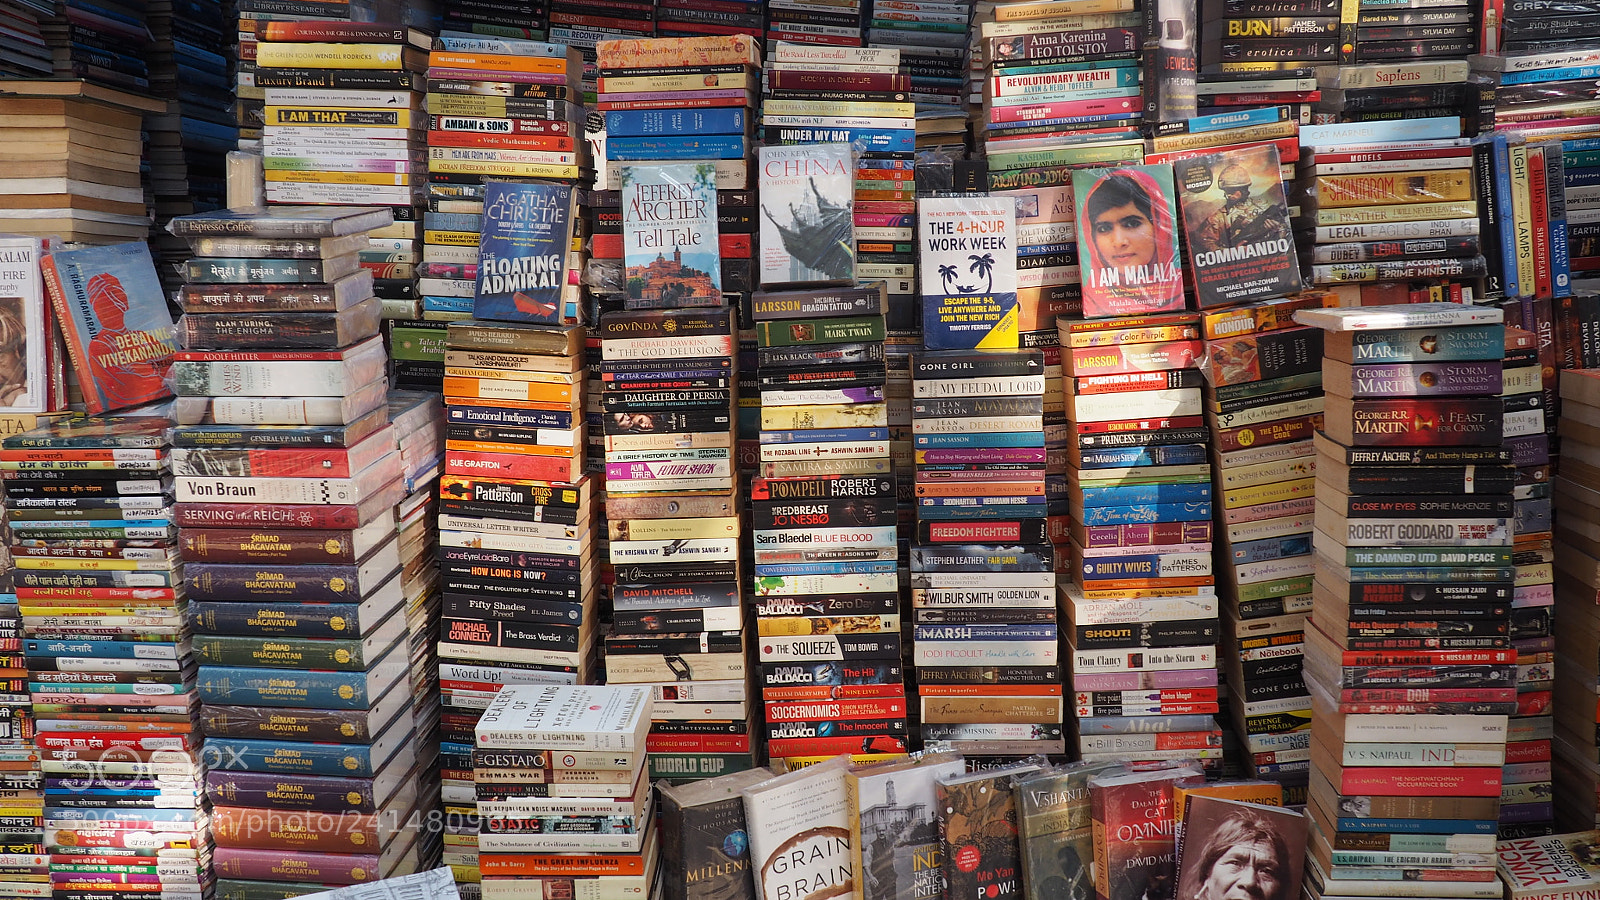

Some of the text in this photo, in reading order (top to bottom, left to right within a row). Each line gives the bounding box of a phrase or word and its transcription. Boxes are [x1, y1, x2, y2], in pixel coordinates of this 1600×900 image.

[1228, 20, 1272, 36] BURN
[1031, 32, 1106, 46] Anna Karenina
[1030, 43, 1108, 59] LEO TOLSTOY
[1165, 56, 1195, 71] JEWELS
[257, 77, 325, 87] Luxury Brand
[1007, 71, 1110, 87] REVOLUTIONARY WEALTH
[1376, 70, 1421, 84] Sapiens
[312, 112, 347, 122] THAT
[1210, 114, 1250, 124] OTHELLO
[445, 120, 509, 131] AMBANI SONS
[780, 129, 850, 141] UNDER MY HAT
[1017, 153, 1054, 161] KASHMIR
[1351, 154, 1382, 162] MODELS
[765, 159, 847, 178] CHINA
[1512, 149, 1524, 181] LIGHT
[1329, 175, 1394, 200] SHANTARAM
[495, 193, 558, 207] AGATHA
[635, 182, 697, 208] JEFFREY
[488, 205, 564, 223] CHRISTIE
[625, 198, 707, 222] ARCHER
[189, 221, 254, 232] Espresso Coffee
[929, 220, 1005, 235] THE 4-HOUR
[1328, 222, 1420, 239] LEGAL EAGLES
[633, 228, 701, 247] Tell Tale
[929, 237, 1007, 251] WORK WEEK
[1195, 238, 1288, 267] COMMANDO
[1537, 227, 1546, 280] SHAKESPEARE
[483, 254, 560, 275] FLOATING
[3, 270, 26, 280] FIRE
[1126, 261, 1177, 285] MALALA
[1341, 272, 1366, 280] BARU
[481, 271, 559, 294] ADMIRAL
[70, 274, 98, 340] RAGHURAMARAJU
[755, 300, 800, 313] LARSSON
[608, 321, 658, 332] GOVINDA
[1214, 317, 1255, 335] HONOUR
[116, 328, 170, 349] DEBATING
[824, 328, 872, 338] MARK TWAIN
[1539, 321, 1552, 348] SITA
[631, 339, 708, 348] RICHARD DAWKINS
[98, 341, 177, 368] VIVEKANANDA
[204, 353, 229, 361] ADOLF
[670, 347, 721, 356] DELUSION
[920, 363, 947, 371] GONE
[1077, 355, 1118, 369] LARSSON
[624, 392, 724, 402] DAUGHTER PERSIA
[467, 410, 536, 425] Emotional Intelligence
[1450, 414, 1486, 422] FEAST
[1355, 420, 1410, 433] MARTIN
[1458, 423, 1486, 432] CROWS
[1352, 451, 1411, 462] JEFFREY ARCHER
[450, 458, 500, 469] SUE GRAFTON
[188, 481, 256, 496] Von Braun
[831, 478, 876, 487] ROBERT
[475, 486, 524, 503] Patterson
[771, 481, 826, 498] POMPEII
[831, 487, 877, 496] HARRIS
[185, 510, 234, 520] SERVING
[776, 505, 829, 515] REDBREAST
[757, 534, 777, 544] Sara
[779, 533, 812, 543] Blaedel
[840, 534, 873, 542] BLOOD
[932, 527, 1018, 537] FREEDOM FIGHTERS
[1349, 524, 1454, 540] ROBERT GODDARD
[926, 556, 954, 564] STEPHEN
[471, 566, 547, 580] HOW LONG NOW?
[1096, 562, 1151, 574] GUILTY WIVES
[1162, 564, 1207, 572] PATTERSON
[652, 588, 693, 596] MITCHELL
[929, 592, 993, 604] WILBUR SMITH
[452, 621, 490, 632] MICHAEL
[922, 628, 971, 638] MARSH
[449, 631, 492, 642] CONNELLY
[538, 633, 561, 642] Verdict
[1085, 629, 1131, 638] SHOUT!
[792, 641, 836, 656] SQUEEZE
[1260, 647, 1301, 658] Notebook
[1078, 656, 1121, 667] Tom Clancy
[766, 673, 812, 684] BALDACCI
[771, 704, 840, 719] SOCCERNOMICS
[1124, 718, 1172, 732] Aha!
[490, 733, 523, 741] DEALERS
[484, 754, 545, 767] GESTAPO
[1371, 750, 1414, 760] NAIPAUL
[656, 758, 724, 773] WORLD CUP
[1145, 807, 1167, 818] CAT
[491, 819, 539, 830] STATIC
[500, 840, 533, 848] Substance
[772, 837, 850, 875] GRAIN
[1517, 840, 1569, 885] FLYNN
[1496, 842, 1536, 886] VINCE
[776, 862, 853, 900] BRAIN
[977, 867, 1014, 882] Mo Yan
